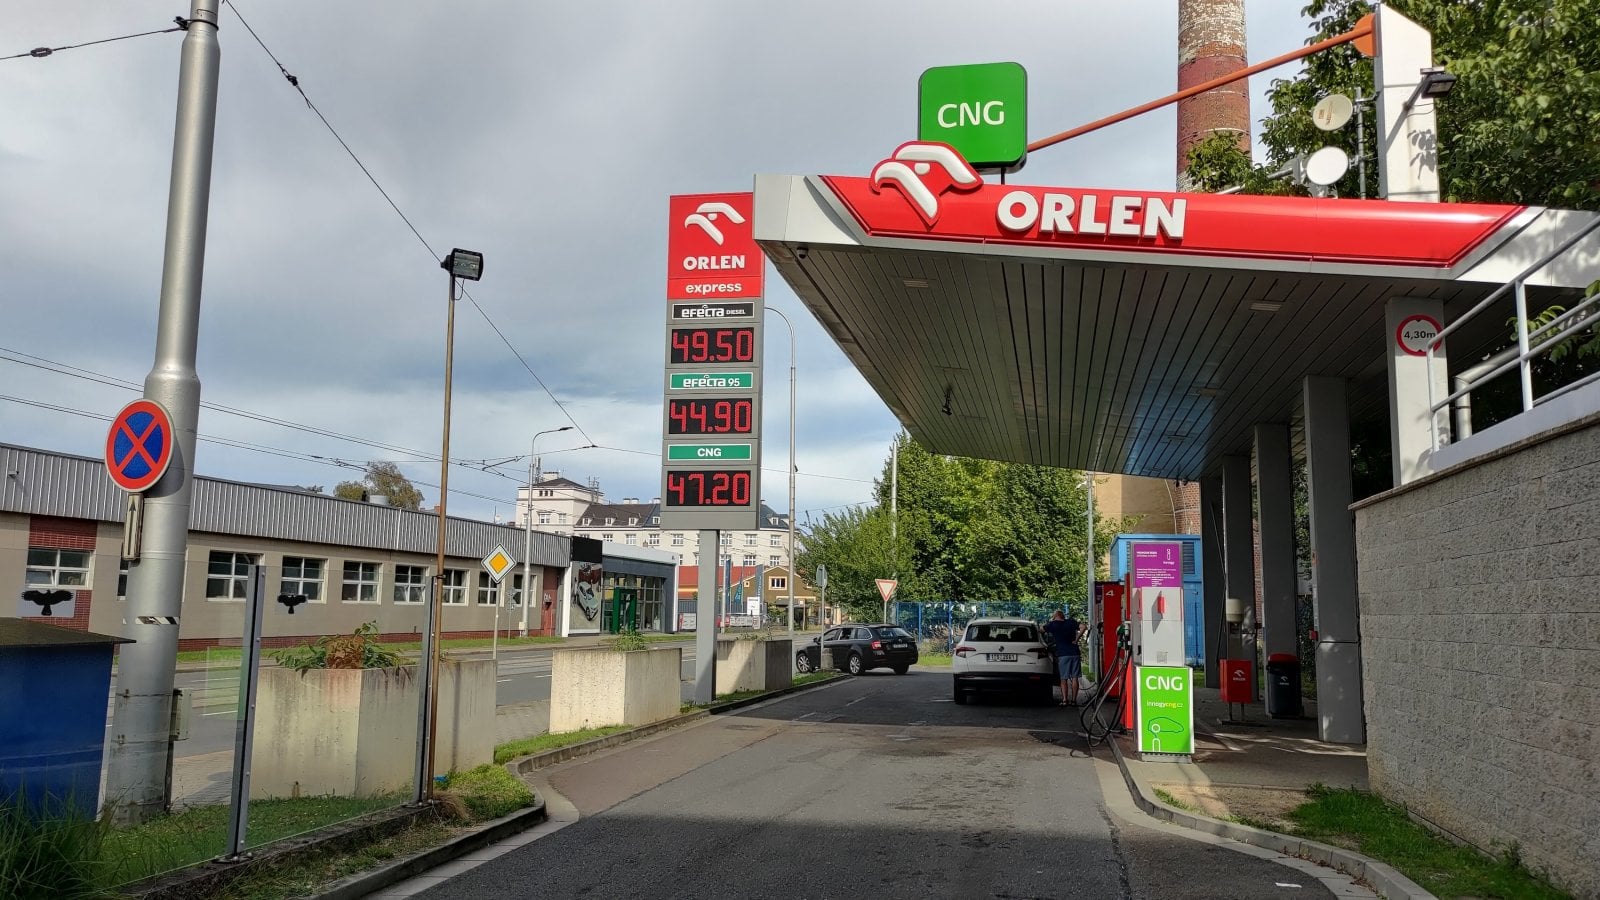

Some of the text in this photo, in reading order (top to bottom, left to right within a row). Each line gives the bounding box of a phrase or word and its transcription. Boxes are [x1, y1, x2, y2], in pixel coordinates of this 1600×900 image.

[937, 100, 1005, 129] CNG
[997, 191, 1187, 239] ORLEN
[683, 255, 746, 271] ORLEN
[685, 282, 742, 295] express
[1404, 330, 1436, 340] 4,30m
[672, 330, 753, 362] 49.50
[727, 378, 740, 387] 95
[670, 401, 752, 433] 44.90
[697, 448, 722, 457] CNG
[668, 473, 750, 505] 47.20
[1105, 589, 1115, 597] 4
[1145, 675, 1184, 691] CNG
